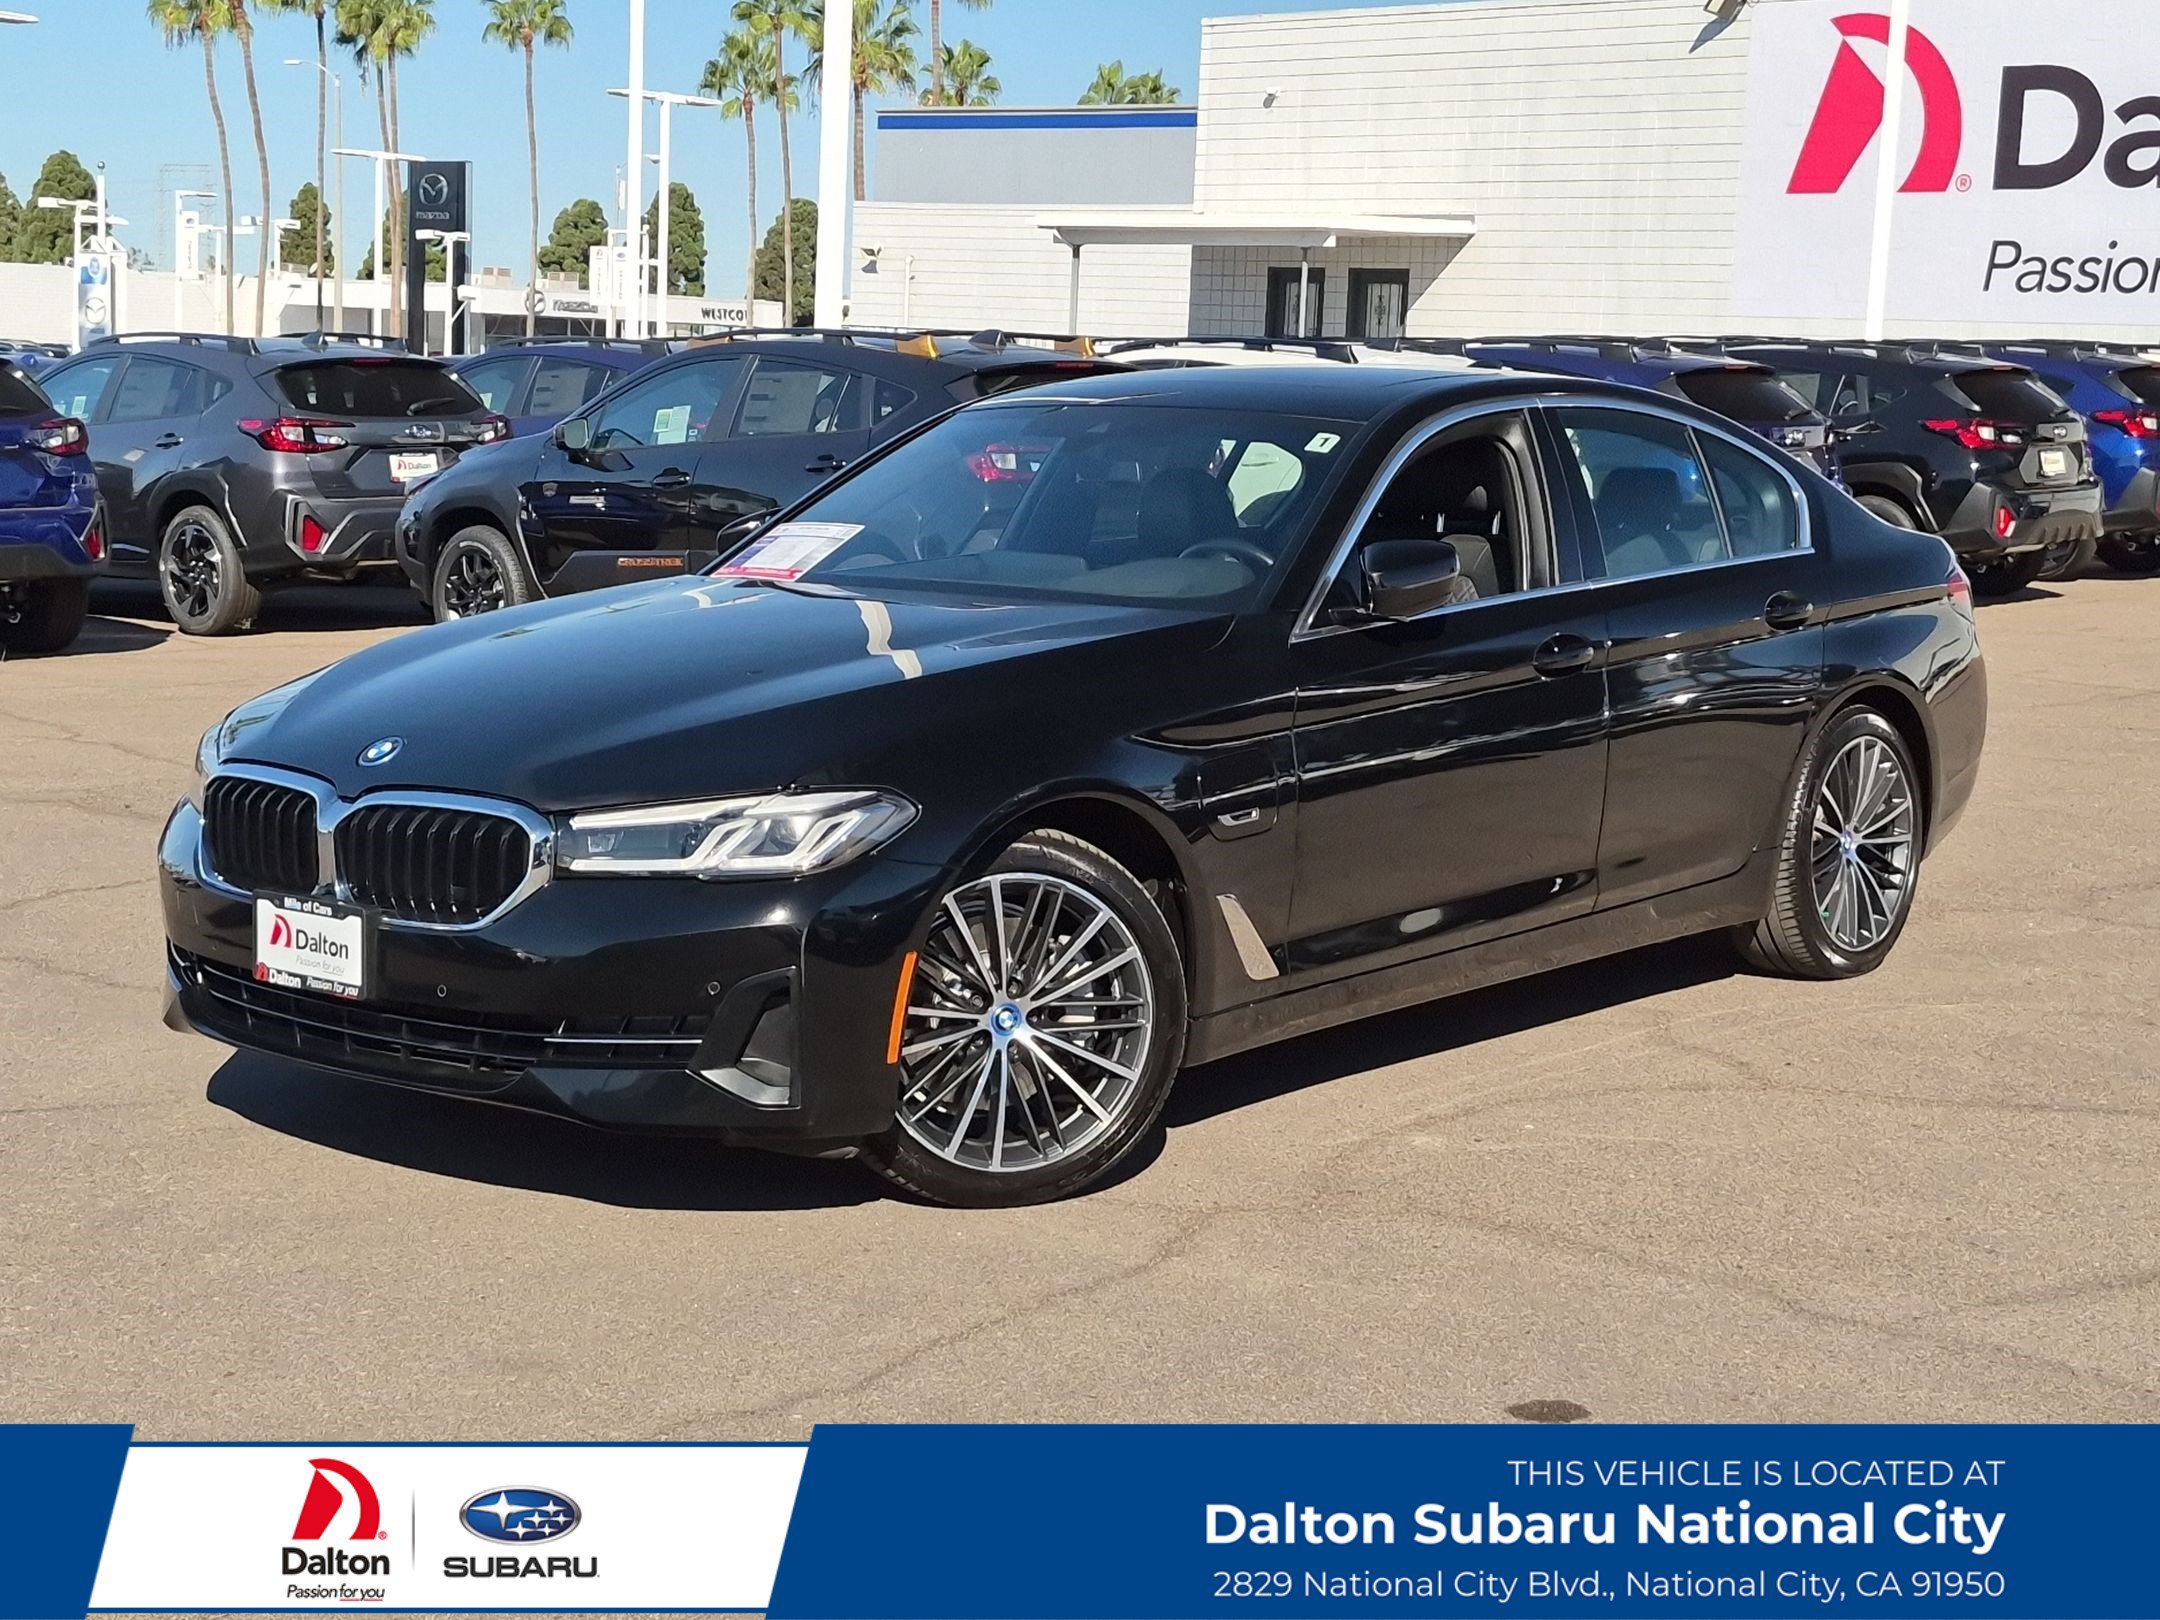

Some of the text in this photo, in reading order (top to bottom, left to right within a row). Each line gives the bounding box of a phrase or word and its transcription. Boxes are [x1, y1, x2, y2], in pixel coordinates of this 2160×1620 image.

[1983, 240, 2160, 293] Passio
[303, 900, 312, 912] of
[312, 901, 333, 916] Cars
[295, 928, 349, 960] Dalton
[296, 954, 321, 969] Passion
[269, 968, 301, 989] Dalton
[306, 976, 359, 997] Passion for you
